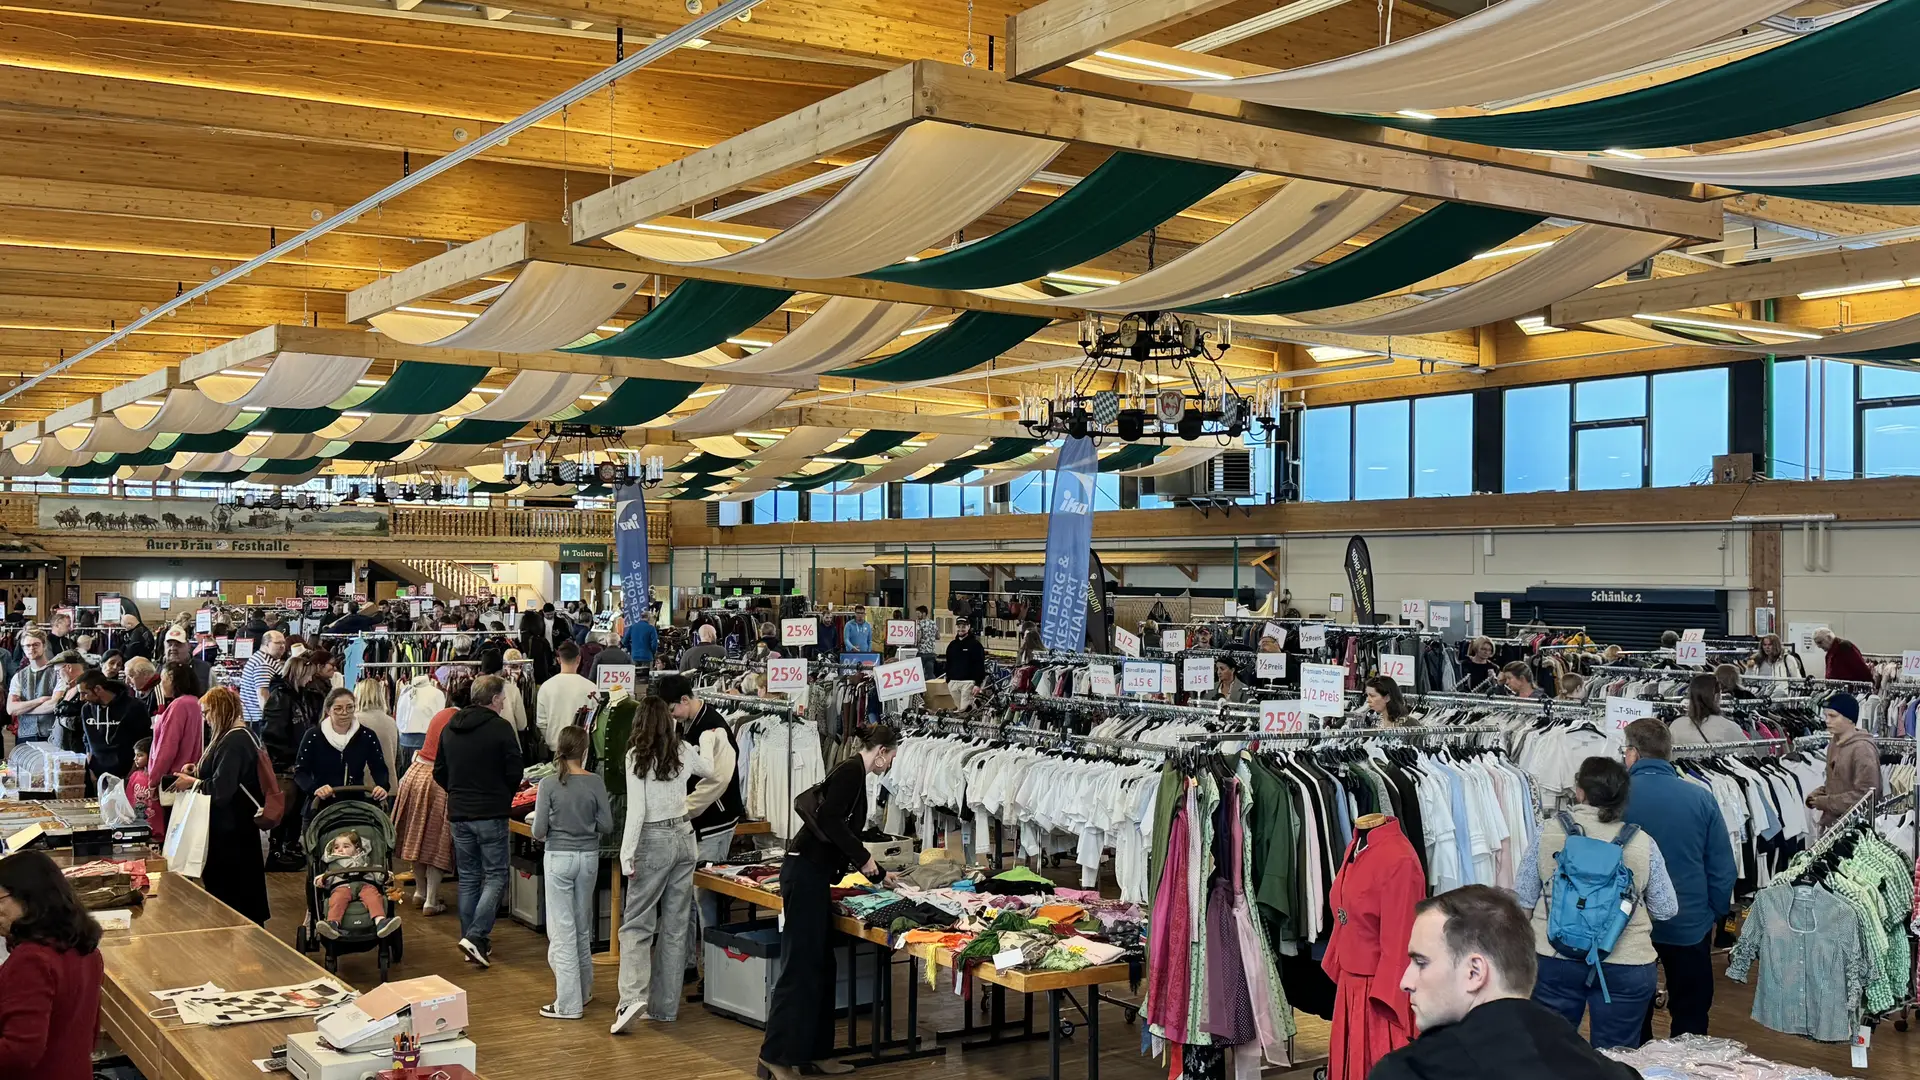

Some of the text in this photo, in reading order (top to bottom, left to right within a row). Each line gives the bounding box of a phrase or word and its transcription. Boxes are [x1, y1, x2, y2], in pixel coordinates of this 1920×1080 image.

[232, 540, 290, 551] Festhalle
[572, 549, 604, 557] Toiletten
[1048, 571, 1066, 616] BERG
[1058, 555, 1069, 568] &
[1591, 590, 1642, 603] Schänke 2
[1403, 603, 1419, 614] 1/2
[786, 624, 814, 638] 25%
[890, 625, 914, 638] 25%
[1117, 632, 1134, 648] 1/2
[1680, 646, 1697, 659] 1/2
[771, 667, 803, 681] 25%
[1382, 661, 1404, 678] 1/2
[603, 670, 631, 684] 25%
[881, 666, 920, 689] 25%
[1134, 678, 1145, 687] 15
[1147, 678, 1153, 688] €
[1194, 675, 1202, 684] 15
[1203, 674, 1208, 684] €
[1303, 687, 1340, 703] 1/2 Preis
[1264, 711, 1303, 732] 25%
